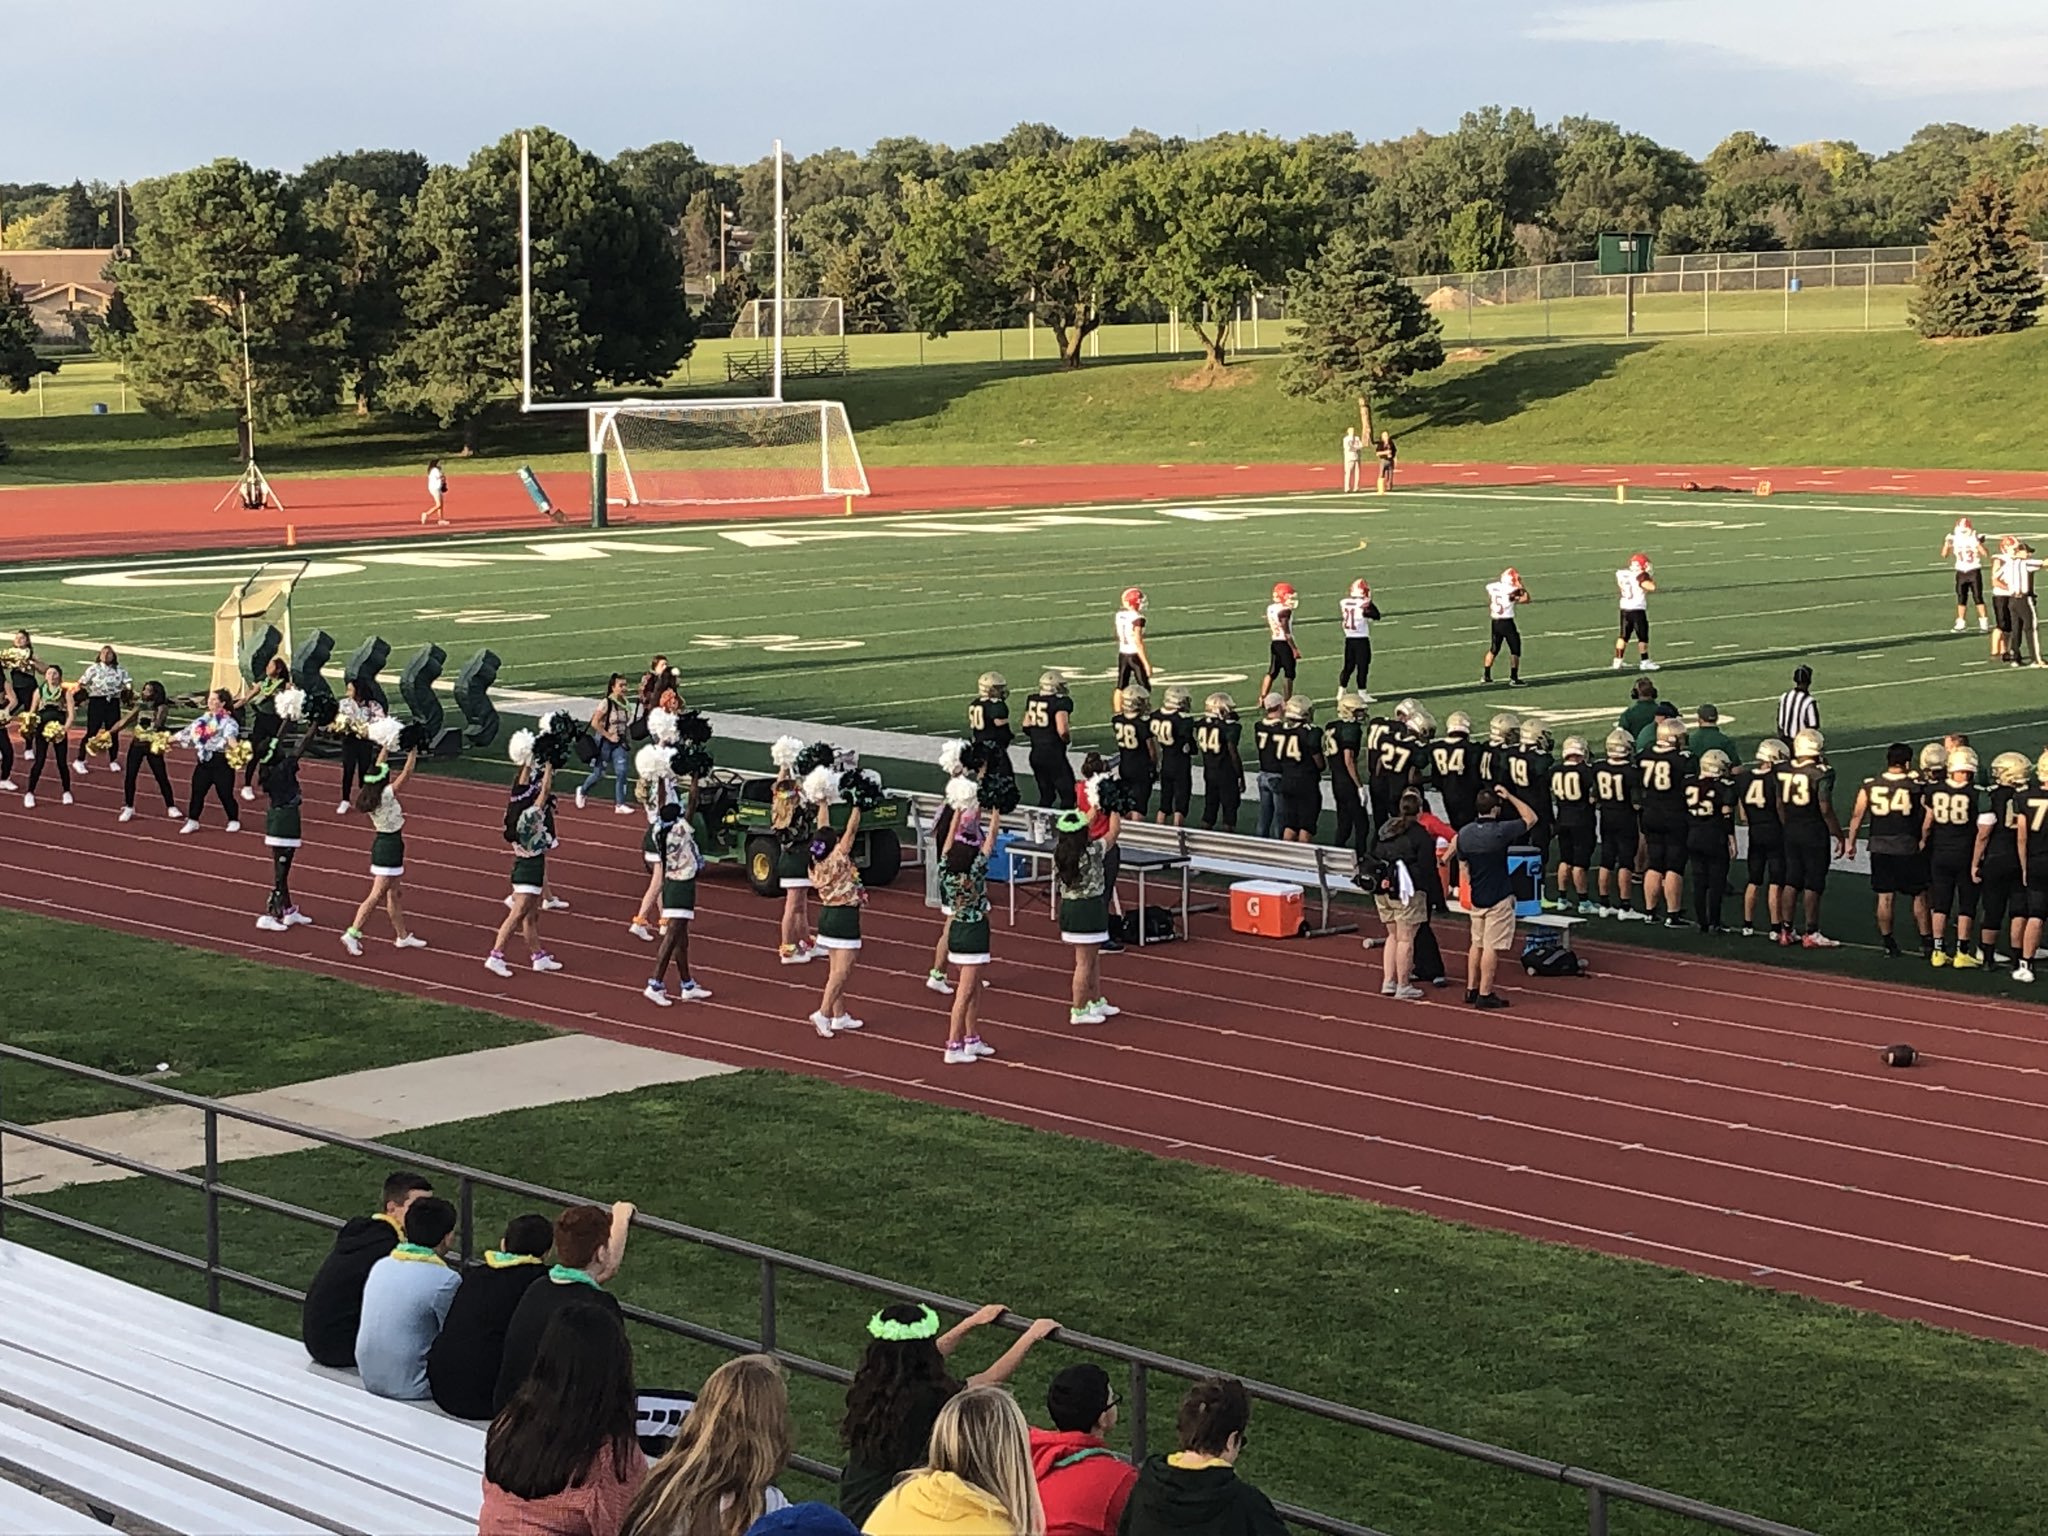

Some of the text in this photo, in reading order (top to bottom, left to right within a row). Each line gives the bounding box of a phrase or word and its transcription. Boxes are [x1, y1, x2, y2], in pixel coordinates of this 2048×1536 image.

[62, 506, 1390, 588] OMAHA
[689, 634, 866, 652] 20
[1113, 721, 1139, 750] 28
[1197, 727, 1221, 755] 44
[1257, 732, 1269, 750] 7
[1272, 734, 1303, 762] 74
[1380, 742, 1412, 773] 27
[1432, 747, 1465, 776] 84
[1508, 757, 1530, 787] 19
[1551, 771, 1582, 801] 40
[1596, 771, 1625, 801] 81
[1639, 759, 1672, 791] 78
[1776, 772, 1811, 806] 73
[1869, 785, 1912, 816] 54
[1931, 791, 1970, 825] 88
[2027, 798, 2048, 832] 7
[1246, 896, 1260, 917] G
